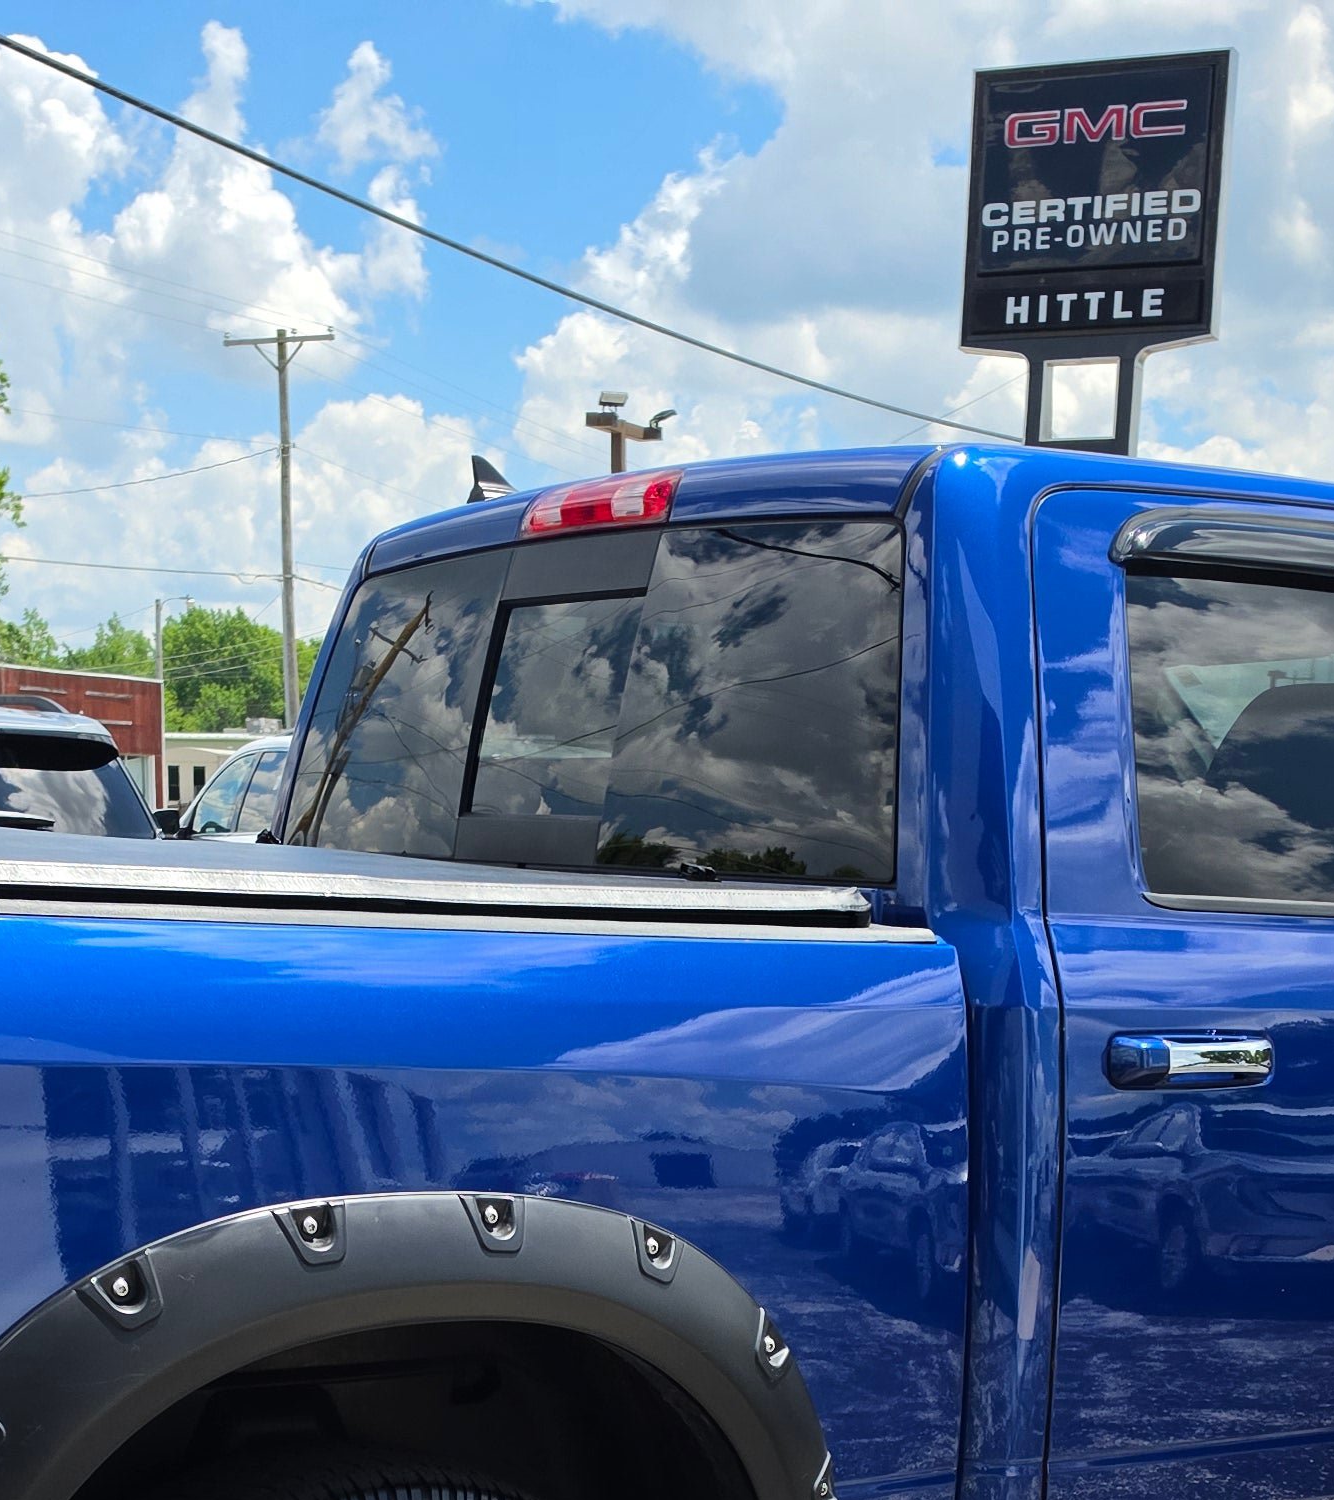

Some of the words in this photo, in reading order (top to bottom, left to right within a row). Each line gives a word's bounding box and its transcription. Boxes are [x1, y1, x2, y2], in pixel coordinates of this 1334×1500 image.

[1004, 99, 1188, 149] GMC
[981, 188, 1202, 227] CERTIFIED
[991, 217, 1188, 253] PRE-OWNED
[1005, 288, 1165, 325] HITTLE
